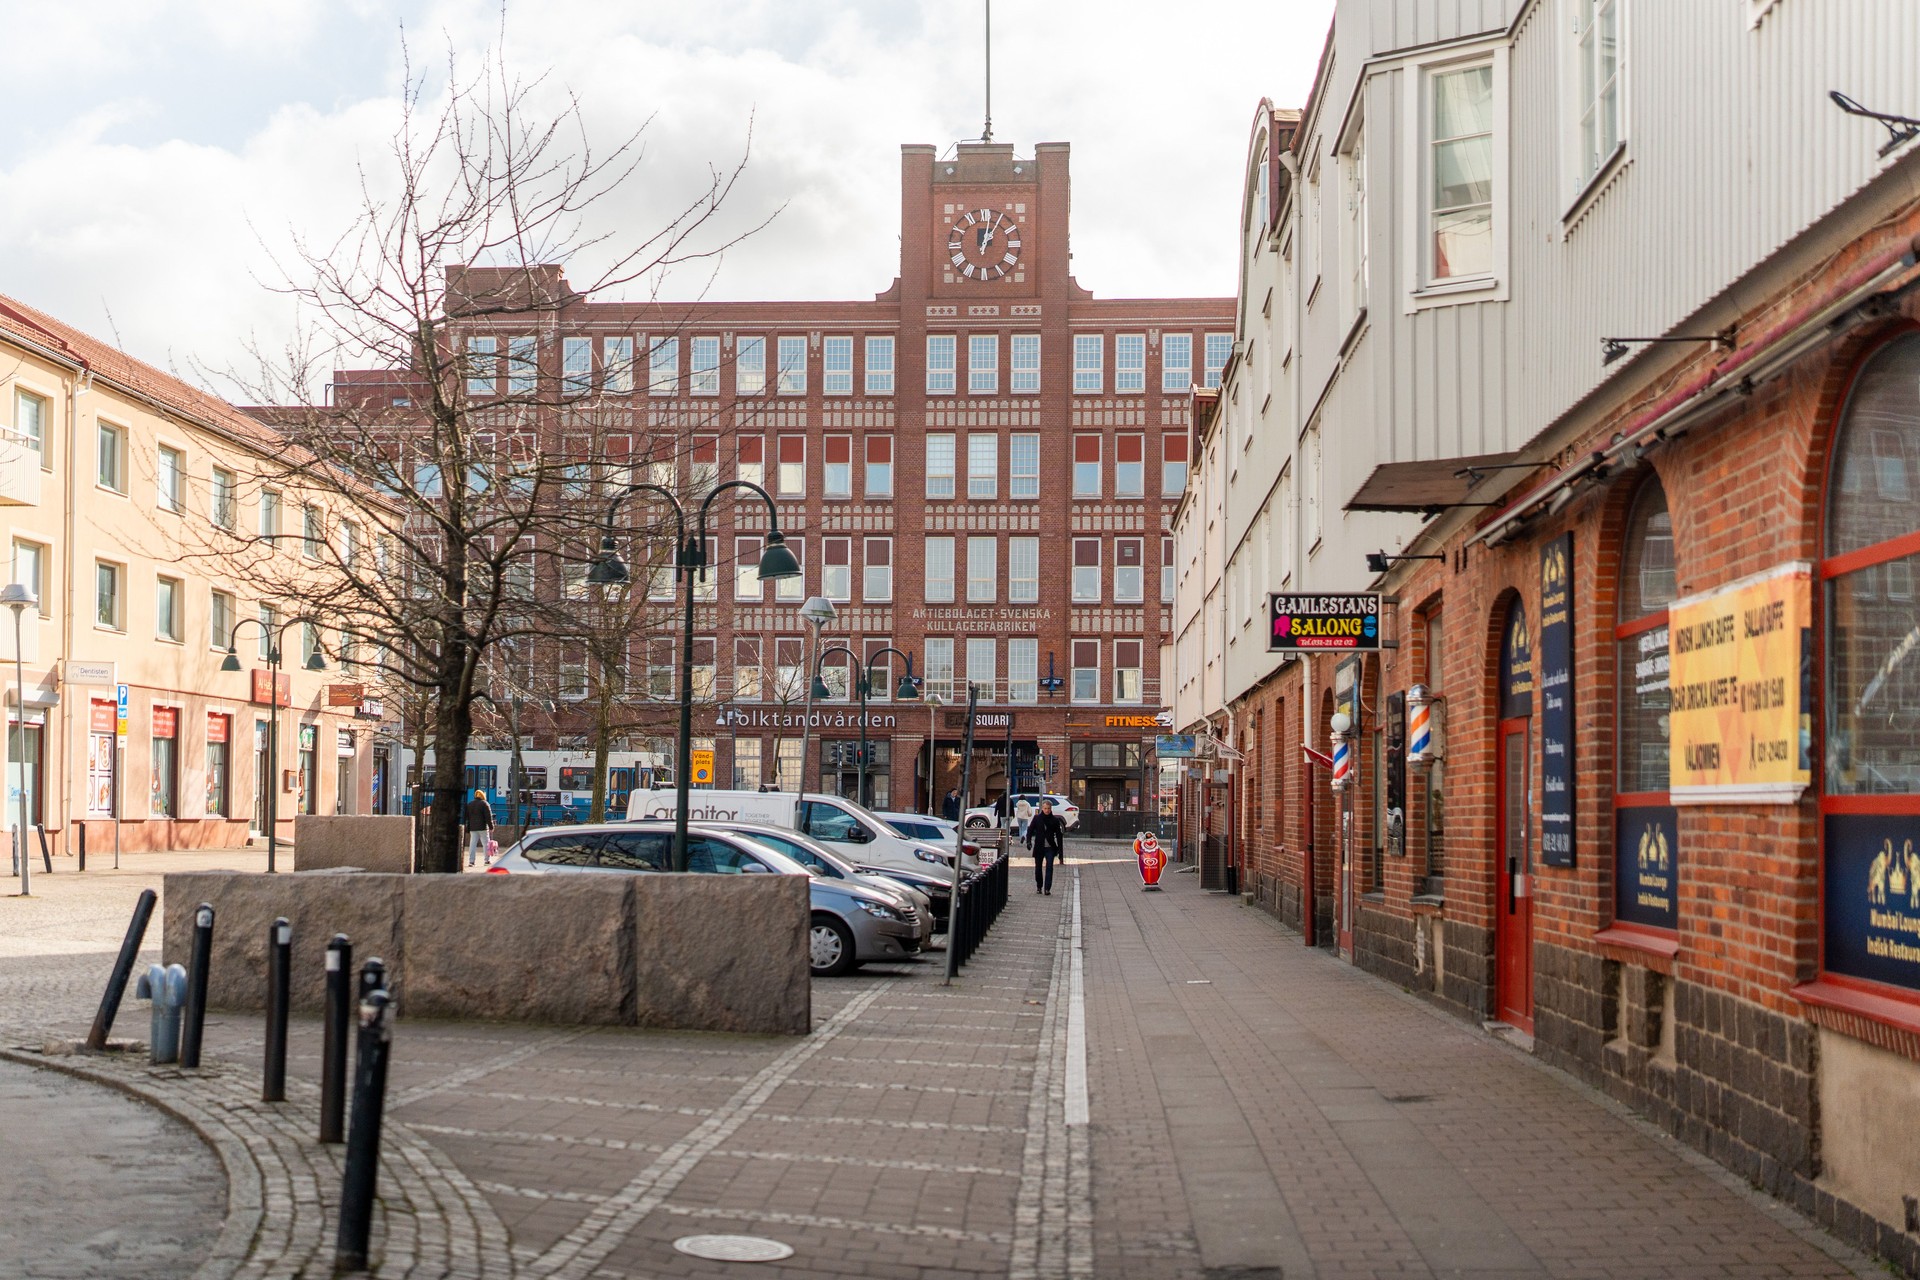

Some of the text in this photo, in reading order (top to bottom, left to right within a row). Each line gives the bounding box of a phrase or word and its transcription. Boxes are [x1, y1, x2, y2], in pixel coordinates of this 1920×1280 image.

[913, 608, 1051, 619] AKTIEBOLAGET SVENSKA
[1275, 597, 1377, 614] GAMLESTANS
[1766, 600, 1785, 632] BUFFE
[927, 621, 1036, 632] KULLAGERFABRIKEN
[1291, 618, 1362, 636] SALONG
[1695, 618, 1714, 650] LUNCH
[1716, 613, 1735, 645] BUFFE
[120, 686, 127, 705] P
[1709, 677, 1728, 707] KAFFE
[1729, 675, 1738, 704] TE
[727, 711, 896, 727] Folktandvården
[976, 714, 1009, 726] SQUAR
[1105, 716, 1159, 727] FITNESS
[1870, 909, 1898, 930] Mumbai
[1867, 935, 1889, 957] Indisk
